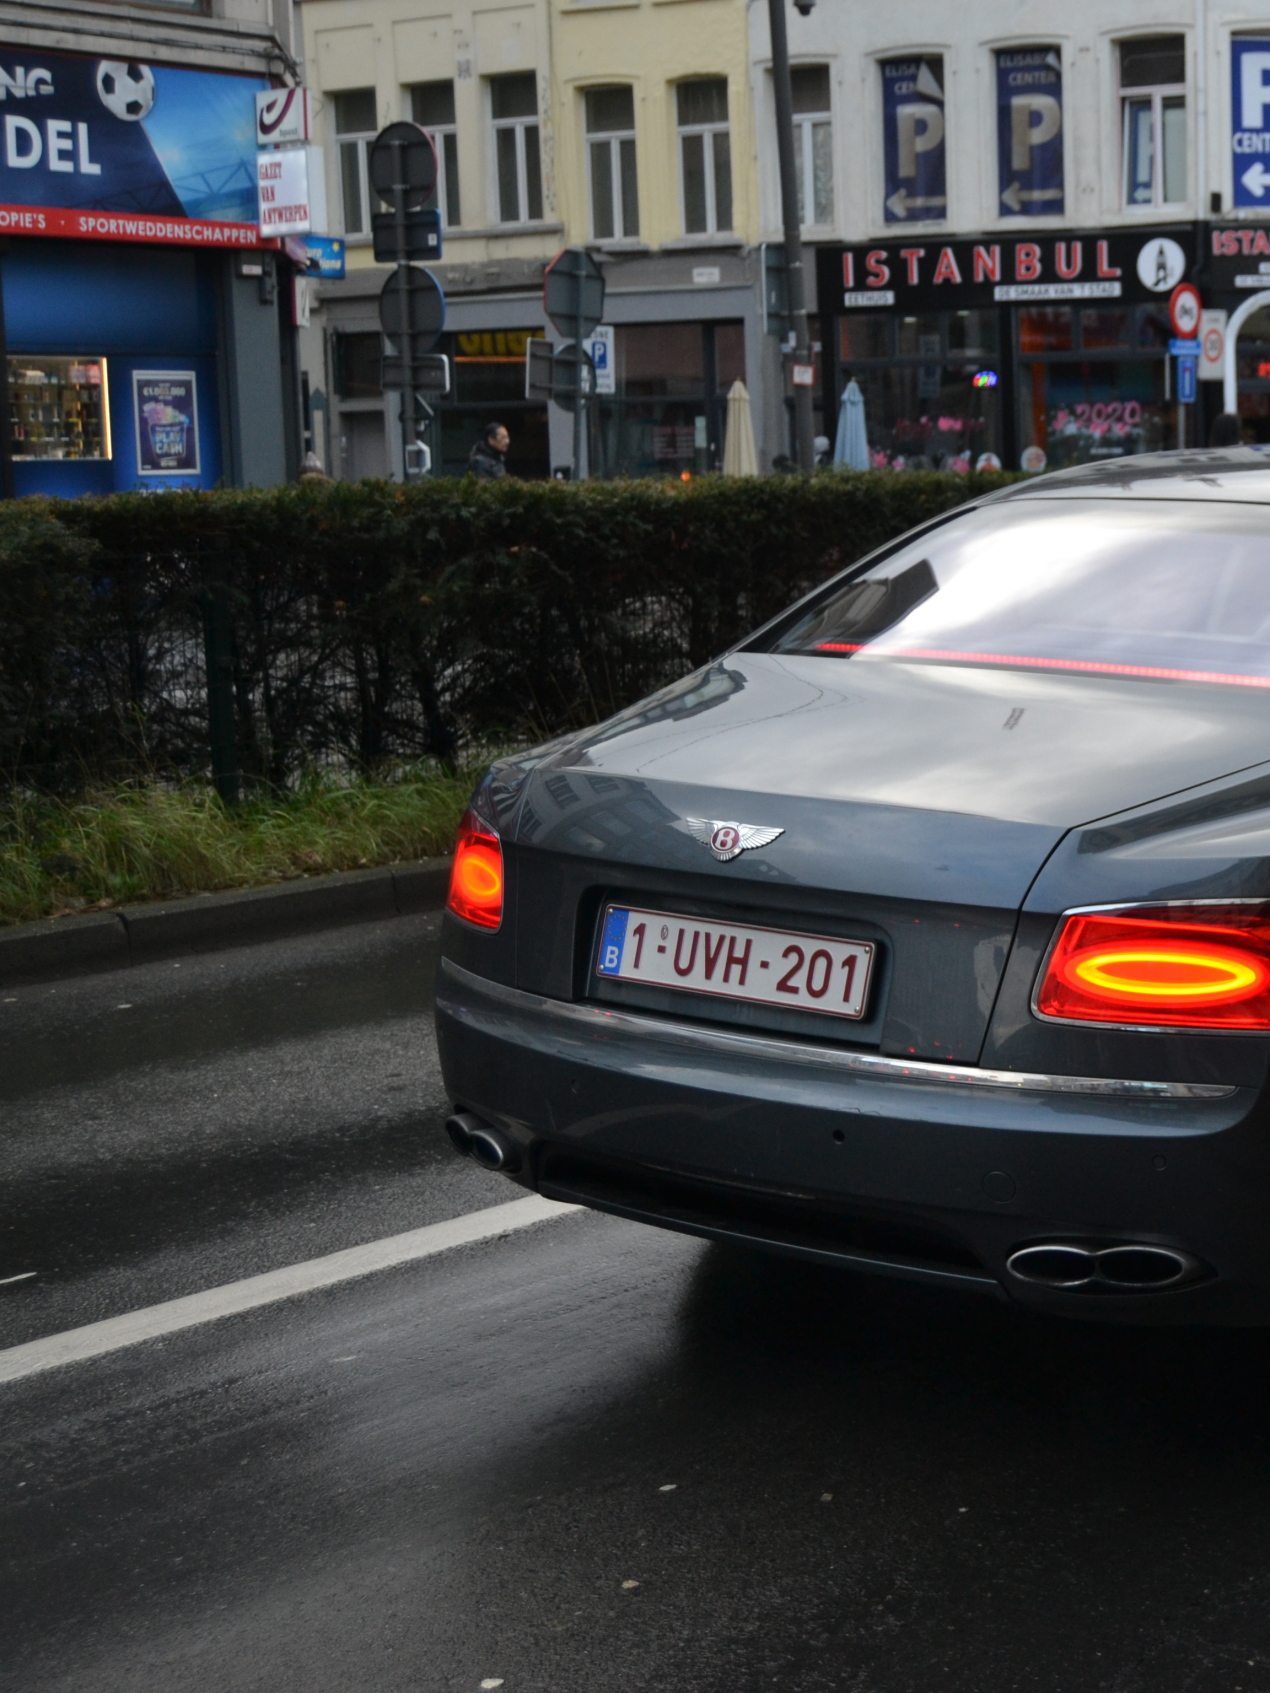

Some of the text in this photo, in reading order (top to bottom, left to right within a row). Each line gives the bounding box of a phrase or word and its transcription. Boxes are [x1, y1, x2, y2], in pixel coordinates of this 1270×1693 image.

[1008, 71, 1057, 86] CENTER
[896, 102, 944, 178] P
[1010, 93, 1061, 171] P
[5, 115, 101, 175] DEL
[259, 162, 282, 181] GAZET
[261, 185, 275, 202] VAN
[263, 204, 309, 225] ANTWERPEN
[79, 217, 257, 244] SPORTWEDDENSCHAPPEN
[843, 240, 1121, 288] ISTANBUL
[848, 291, 888, 305] EETHUIS
[594, 343, 604, 363] P
[1075, 401, 1141, 427] 2020
[155, 432, 183, 443] PLAY
[155, 442, 182, 455] CASH
[604, 946, 619, 968] B
[633, 922, 858, 1003] 1-UVH-201
